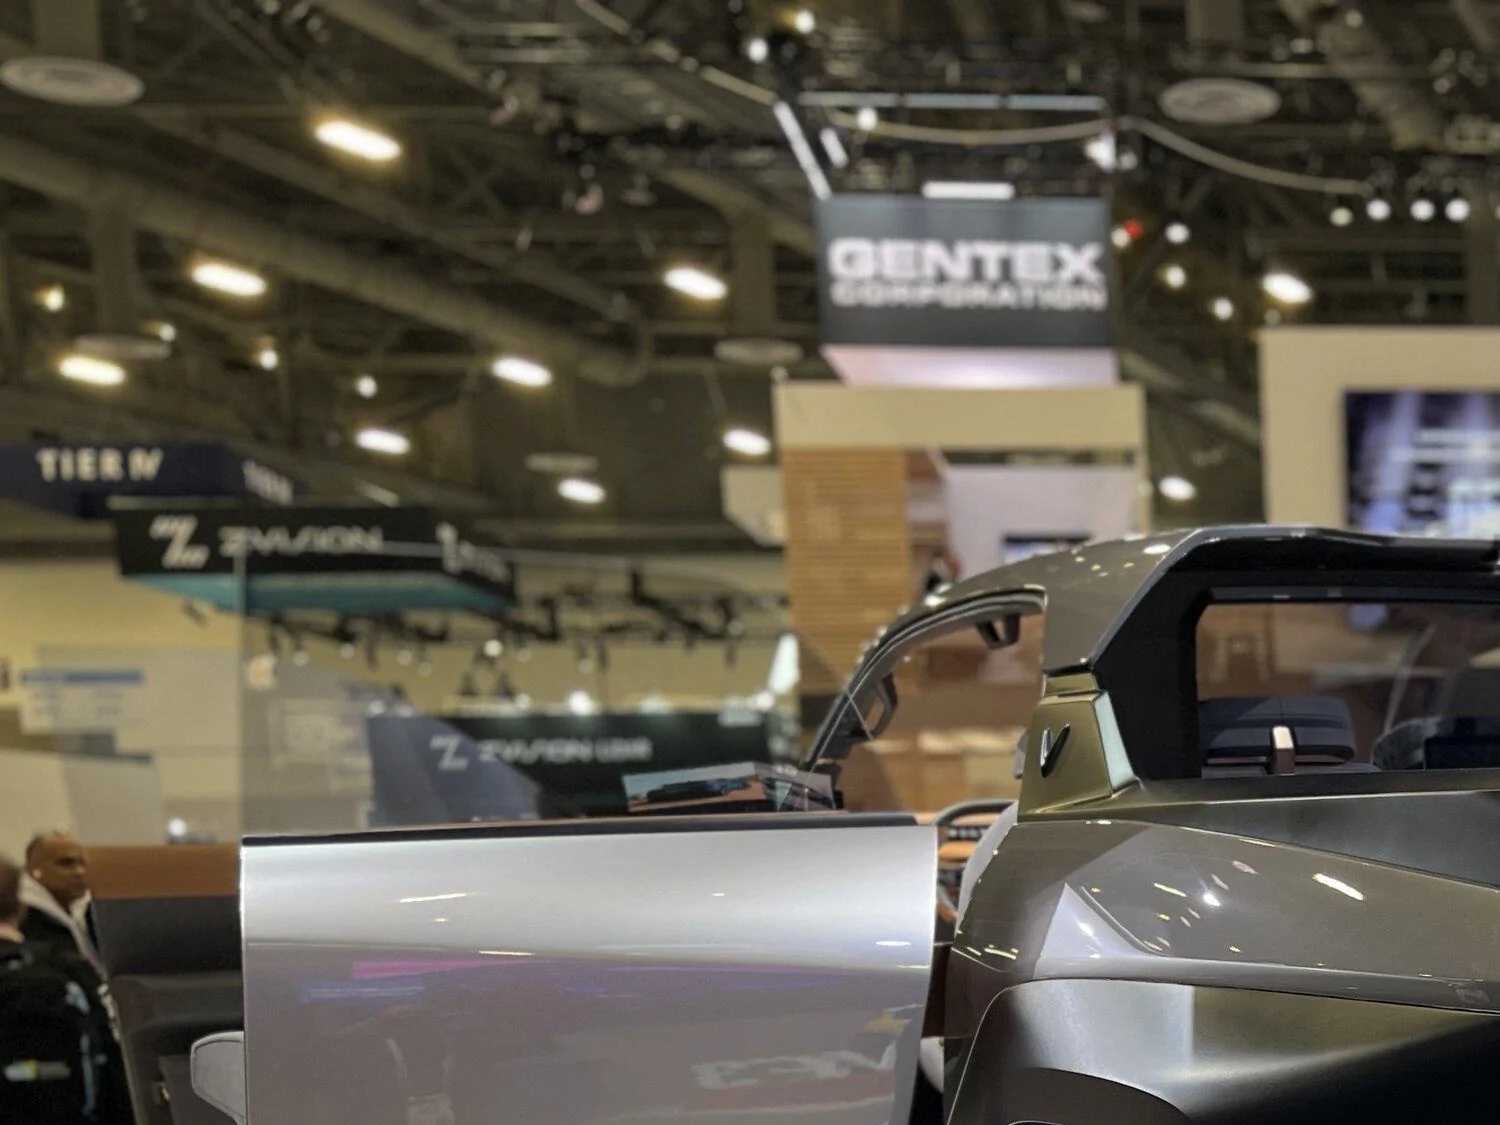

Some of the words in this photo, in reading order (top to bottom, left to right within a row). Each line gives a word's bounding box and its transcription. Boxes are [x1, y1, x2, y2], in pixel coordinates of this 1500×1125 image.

[828, 238, 1104, 283] GENTEX
[831, 281, 1107, 310] CORPORATION
[36, 447, 124, 482] TIER
